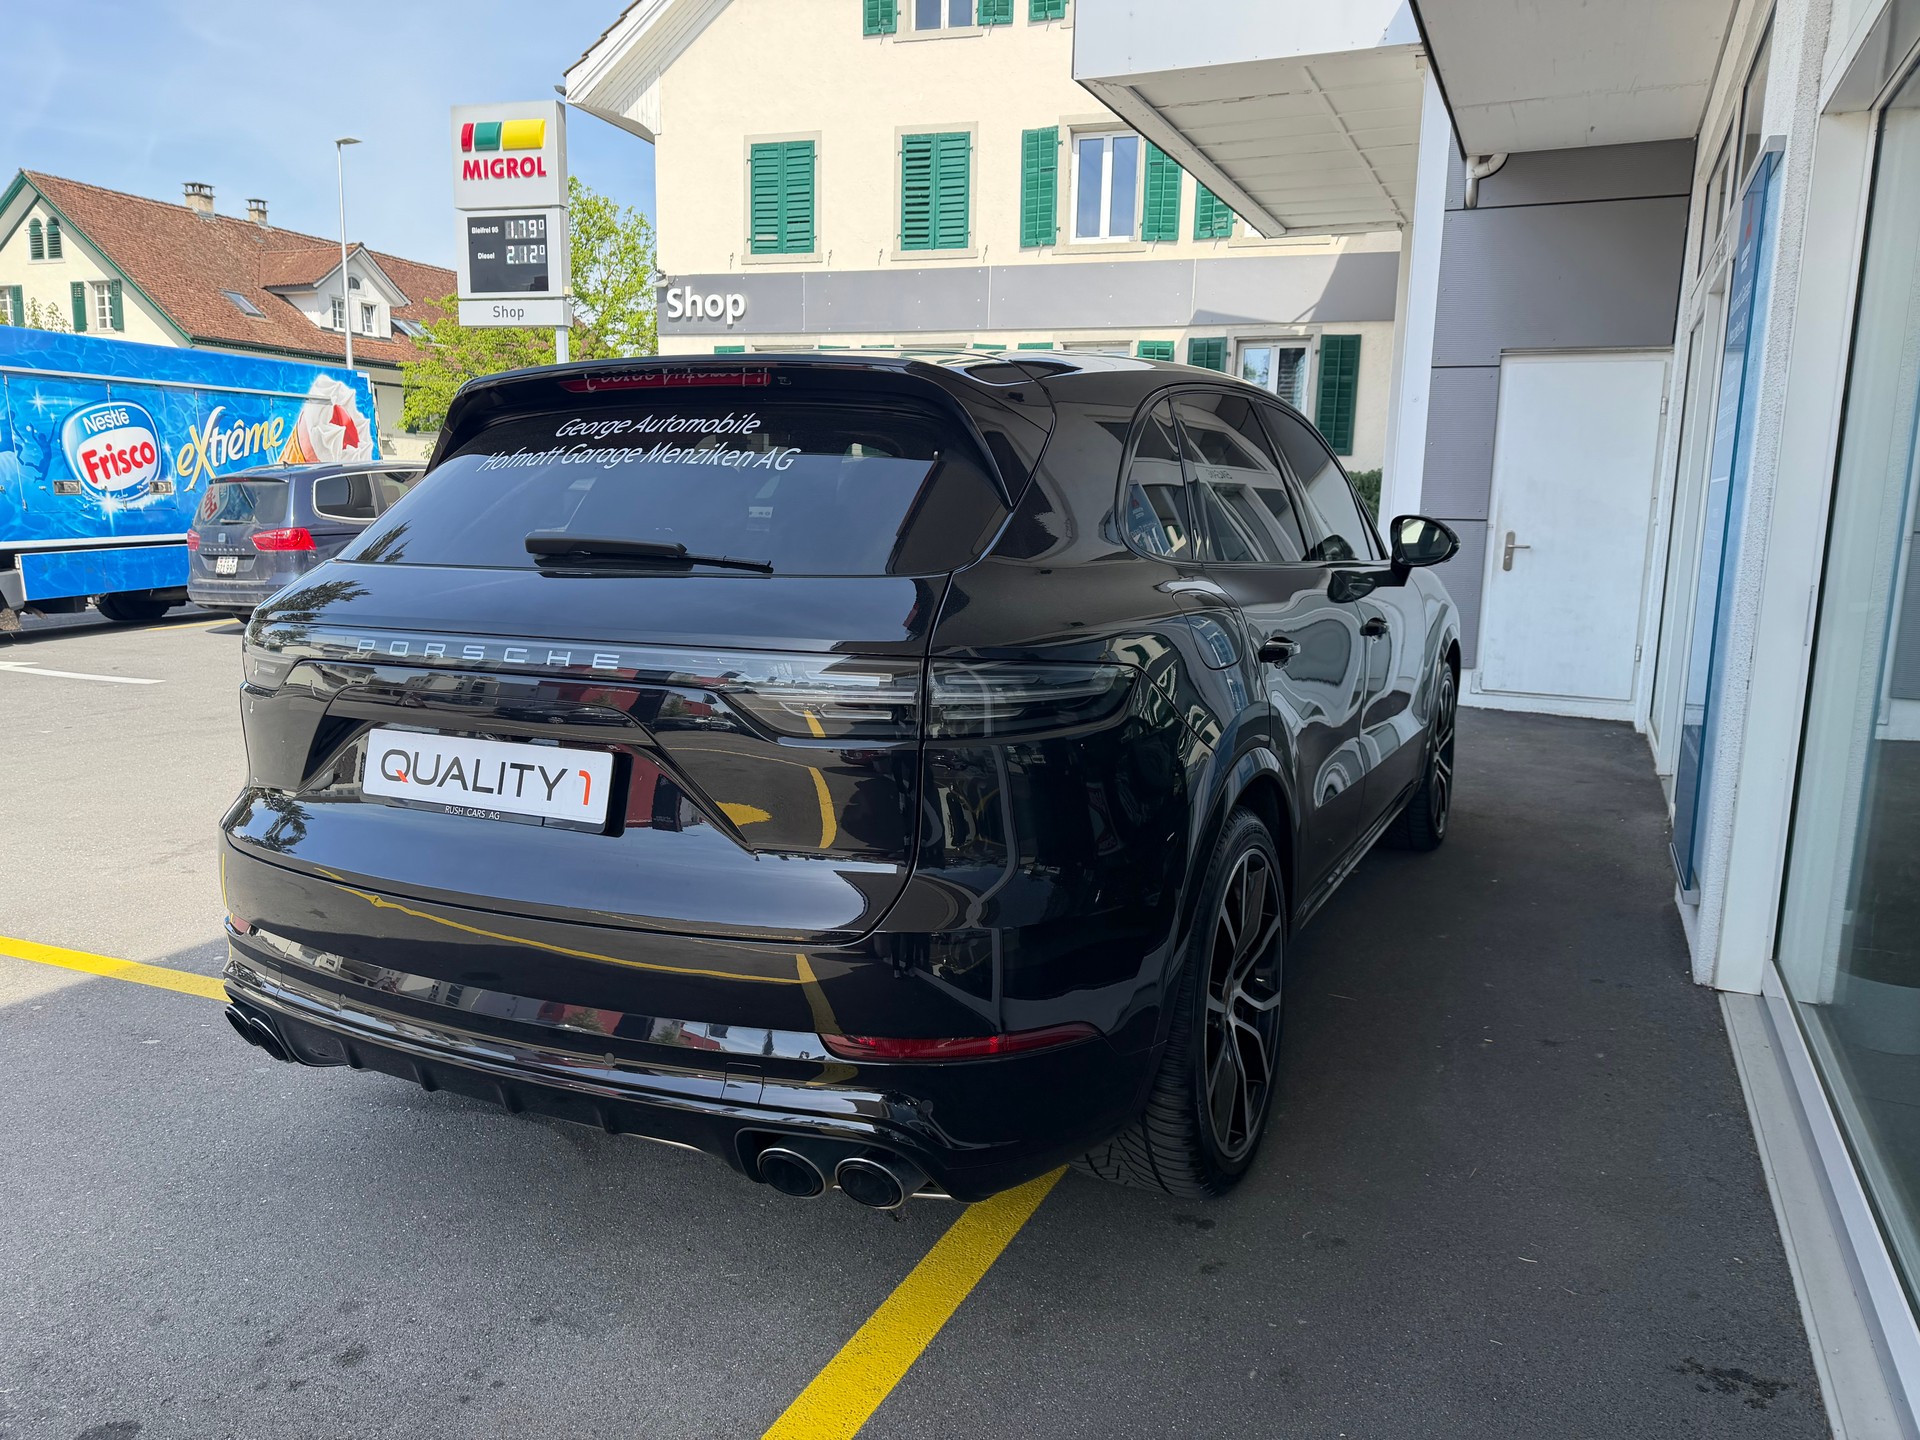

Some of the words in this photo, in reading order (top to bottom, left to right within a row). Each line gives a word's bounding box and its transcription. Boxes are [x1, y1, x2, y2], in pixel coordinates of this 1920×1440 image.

[462, 156, 547, 181] MIGROL
[477, 252, 495, 260] Diesel
[492, 305, 525, 321] Shop
[666, 286, 746, 325] Shop
[555, 417, 632, 440] George
[628, 412, 761, 435] Automobile
[81, 441, 156, 484] Frisco
[476, 446, 567, 472] Hofmatt
[560, 443, 643, 470] Garage
[641, 441, 755, 467] Menziken
[751, 446, 802, 471] AG
[356, 639, 620, 670] PORSCHE
[444, 805, 464, 816] RUSH
[466, 807, 487, 819] CARS
[488, 810, 500, 820] AG
